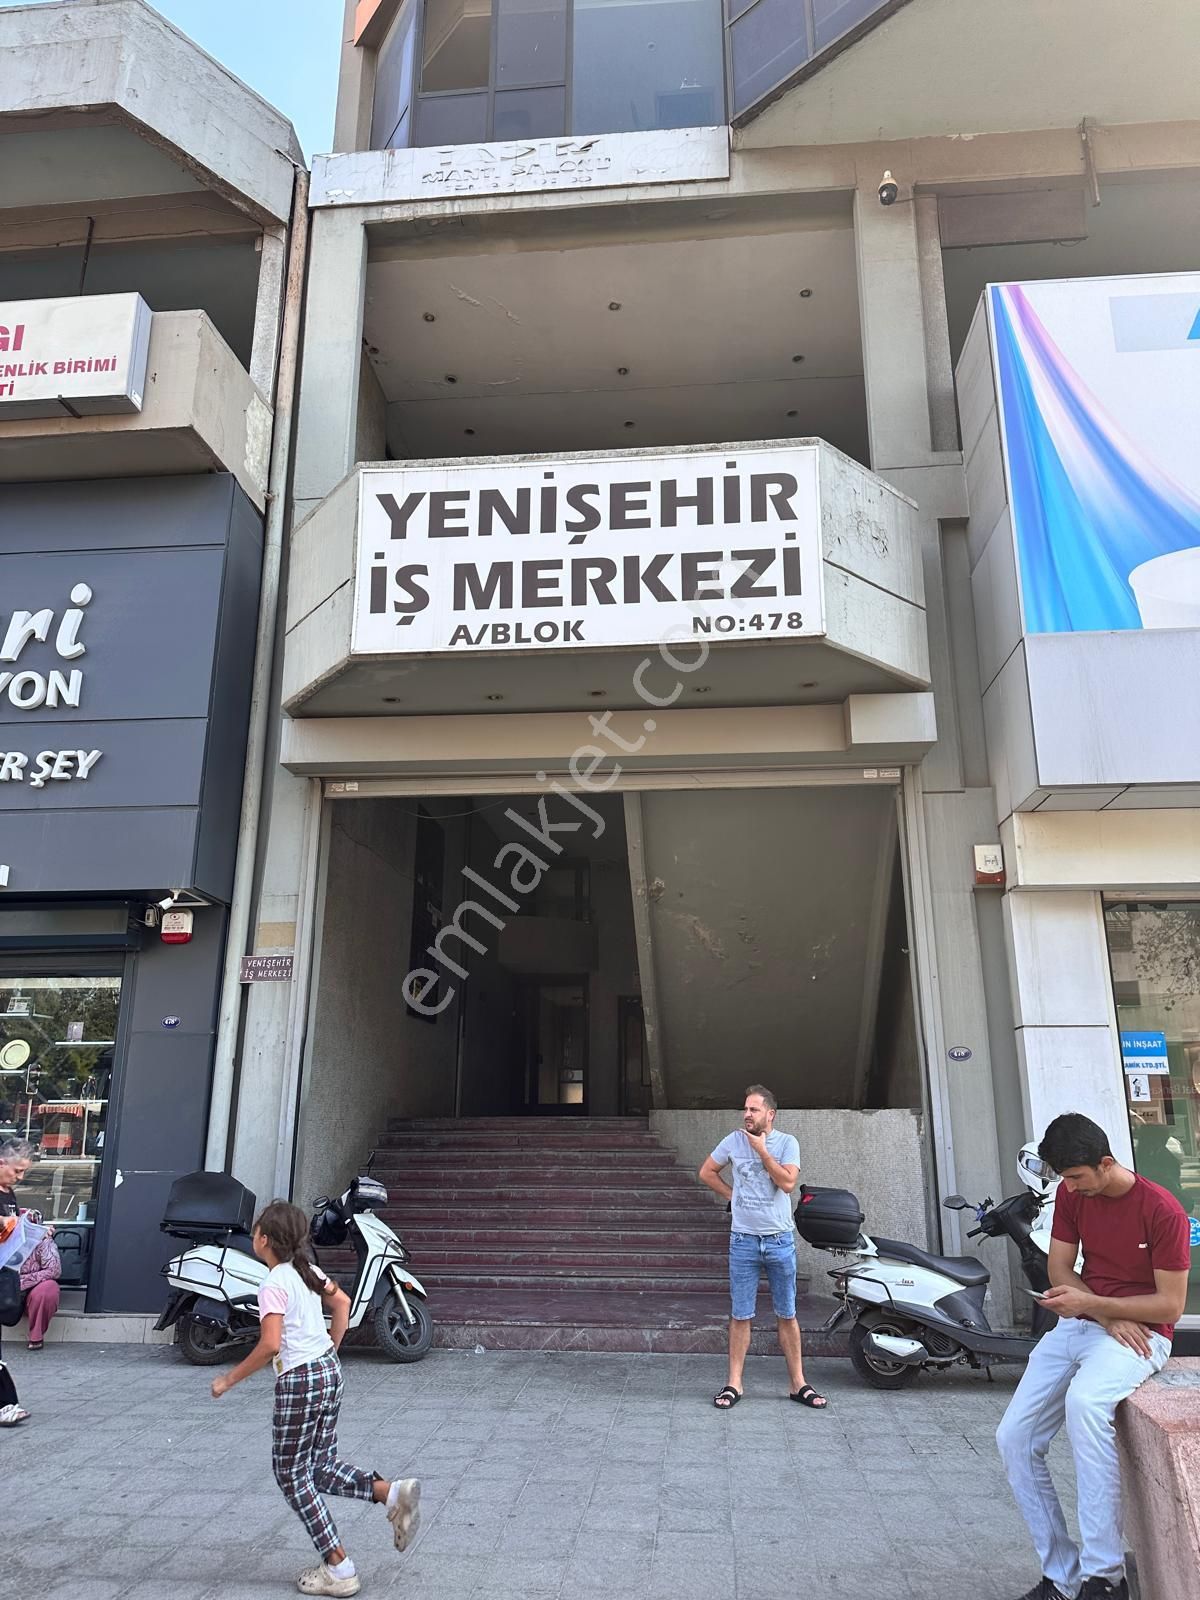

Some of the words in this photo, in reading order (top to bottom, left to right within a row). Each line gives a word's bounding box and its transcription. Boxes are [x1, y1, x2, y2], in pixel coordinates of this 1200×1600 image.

[53, 355, 117, 374] BİRİMİ
[376, 461, 799, 545] YENİŞEHİR
[370, 551, 430, 626] İŞ
[452, 532, 802, 612] MERKEZİ
[448, 619, 585, 646] A/BLOK
[692, 612, 803, 633] NO:478
[30, 749, 104, 788] ŞEY
[244, 968, 255, 980] İŞ
[257, 967, 292, 978] MERKEZİ
[247, 957, 292, 969] YENİŞEHİR
